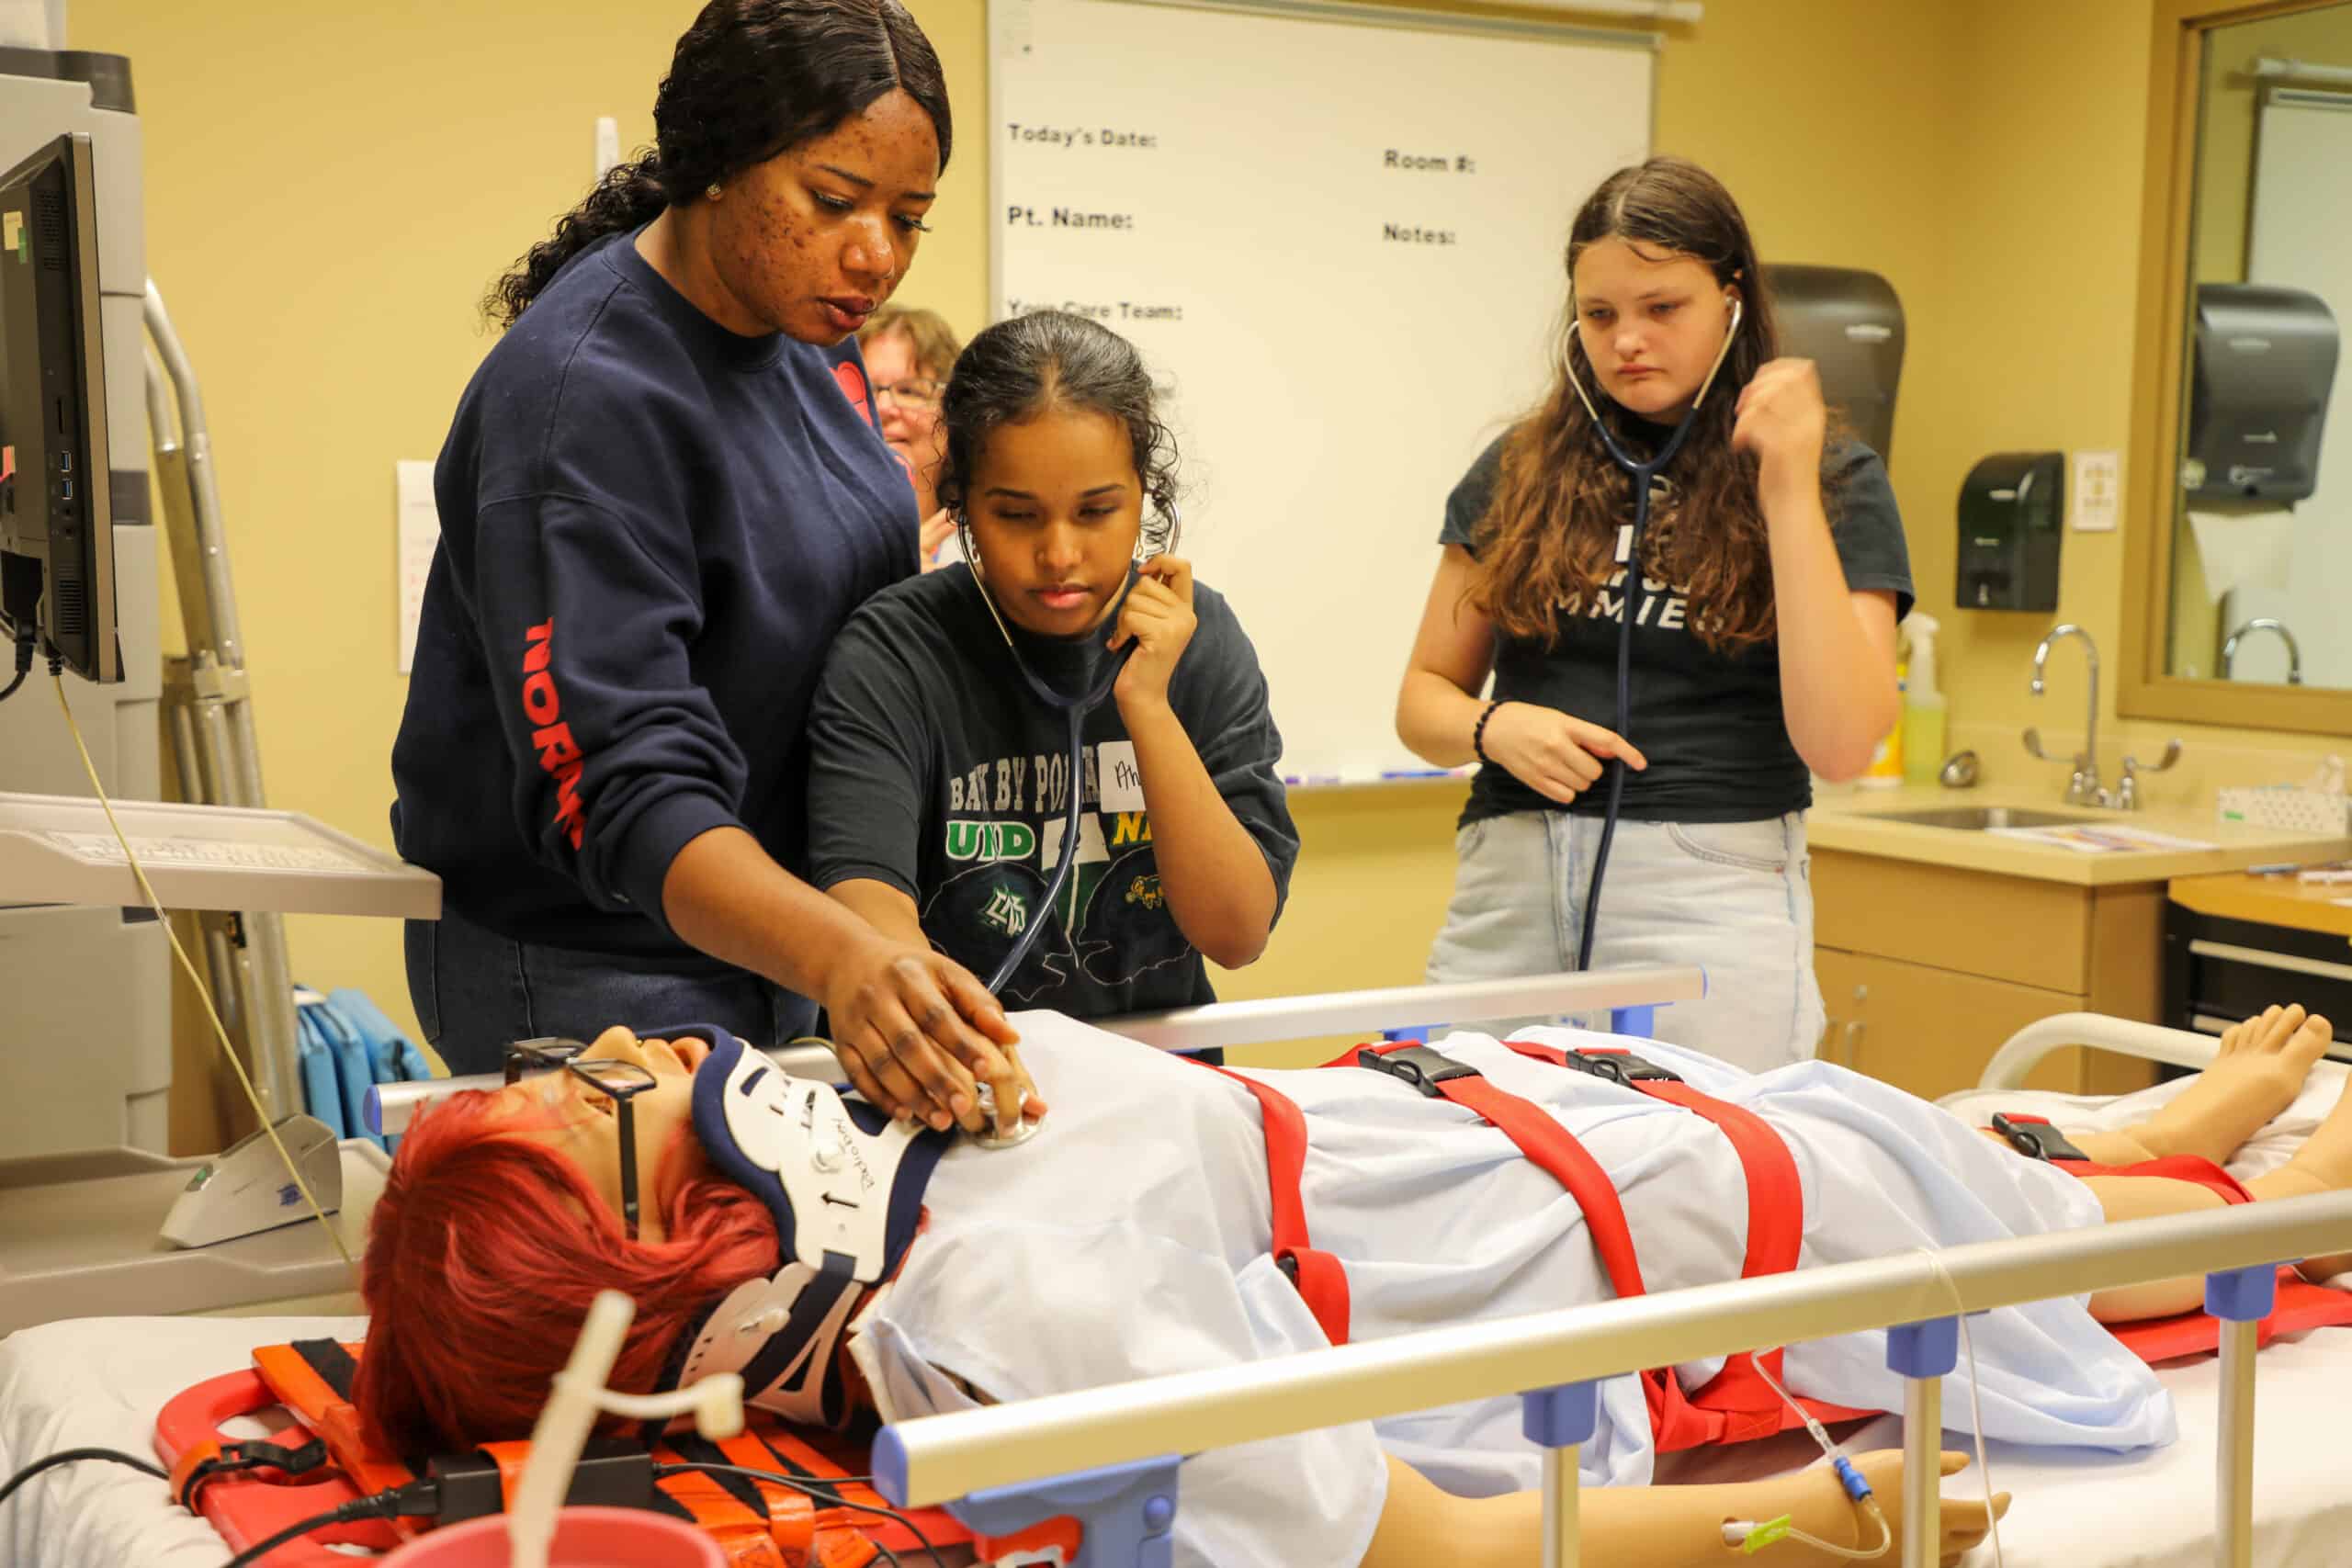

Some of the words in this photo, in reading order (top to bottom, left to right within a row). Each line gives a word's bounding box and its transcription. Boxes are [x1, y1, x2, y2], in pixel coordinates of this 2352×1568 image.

[1008, 123, 1093, 148] Today's
[1101, 129, 1157, 147] Date:
[1385, 149, 1448, 172] Room
[1008, 206, 1043, 226] Pt.
[1052, 208, 1133, 230] Name:
[1384, 224, 1456, 245] Notes:
[1118, 301, 1182, 321] Team:
[994, 756, 1027, 810] BY
[944, 819, 1037, 863] UND
